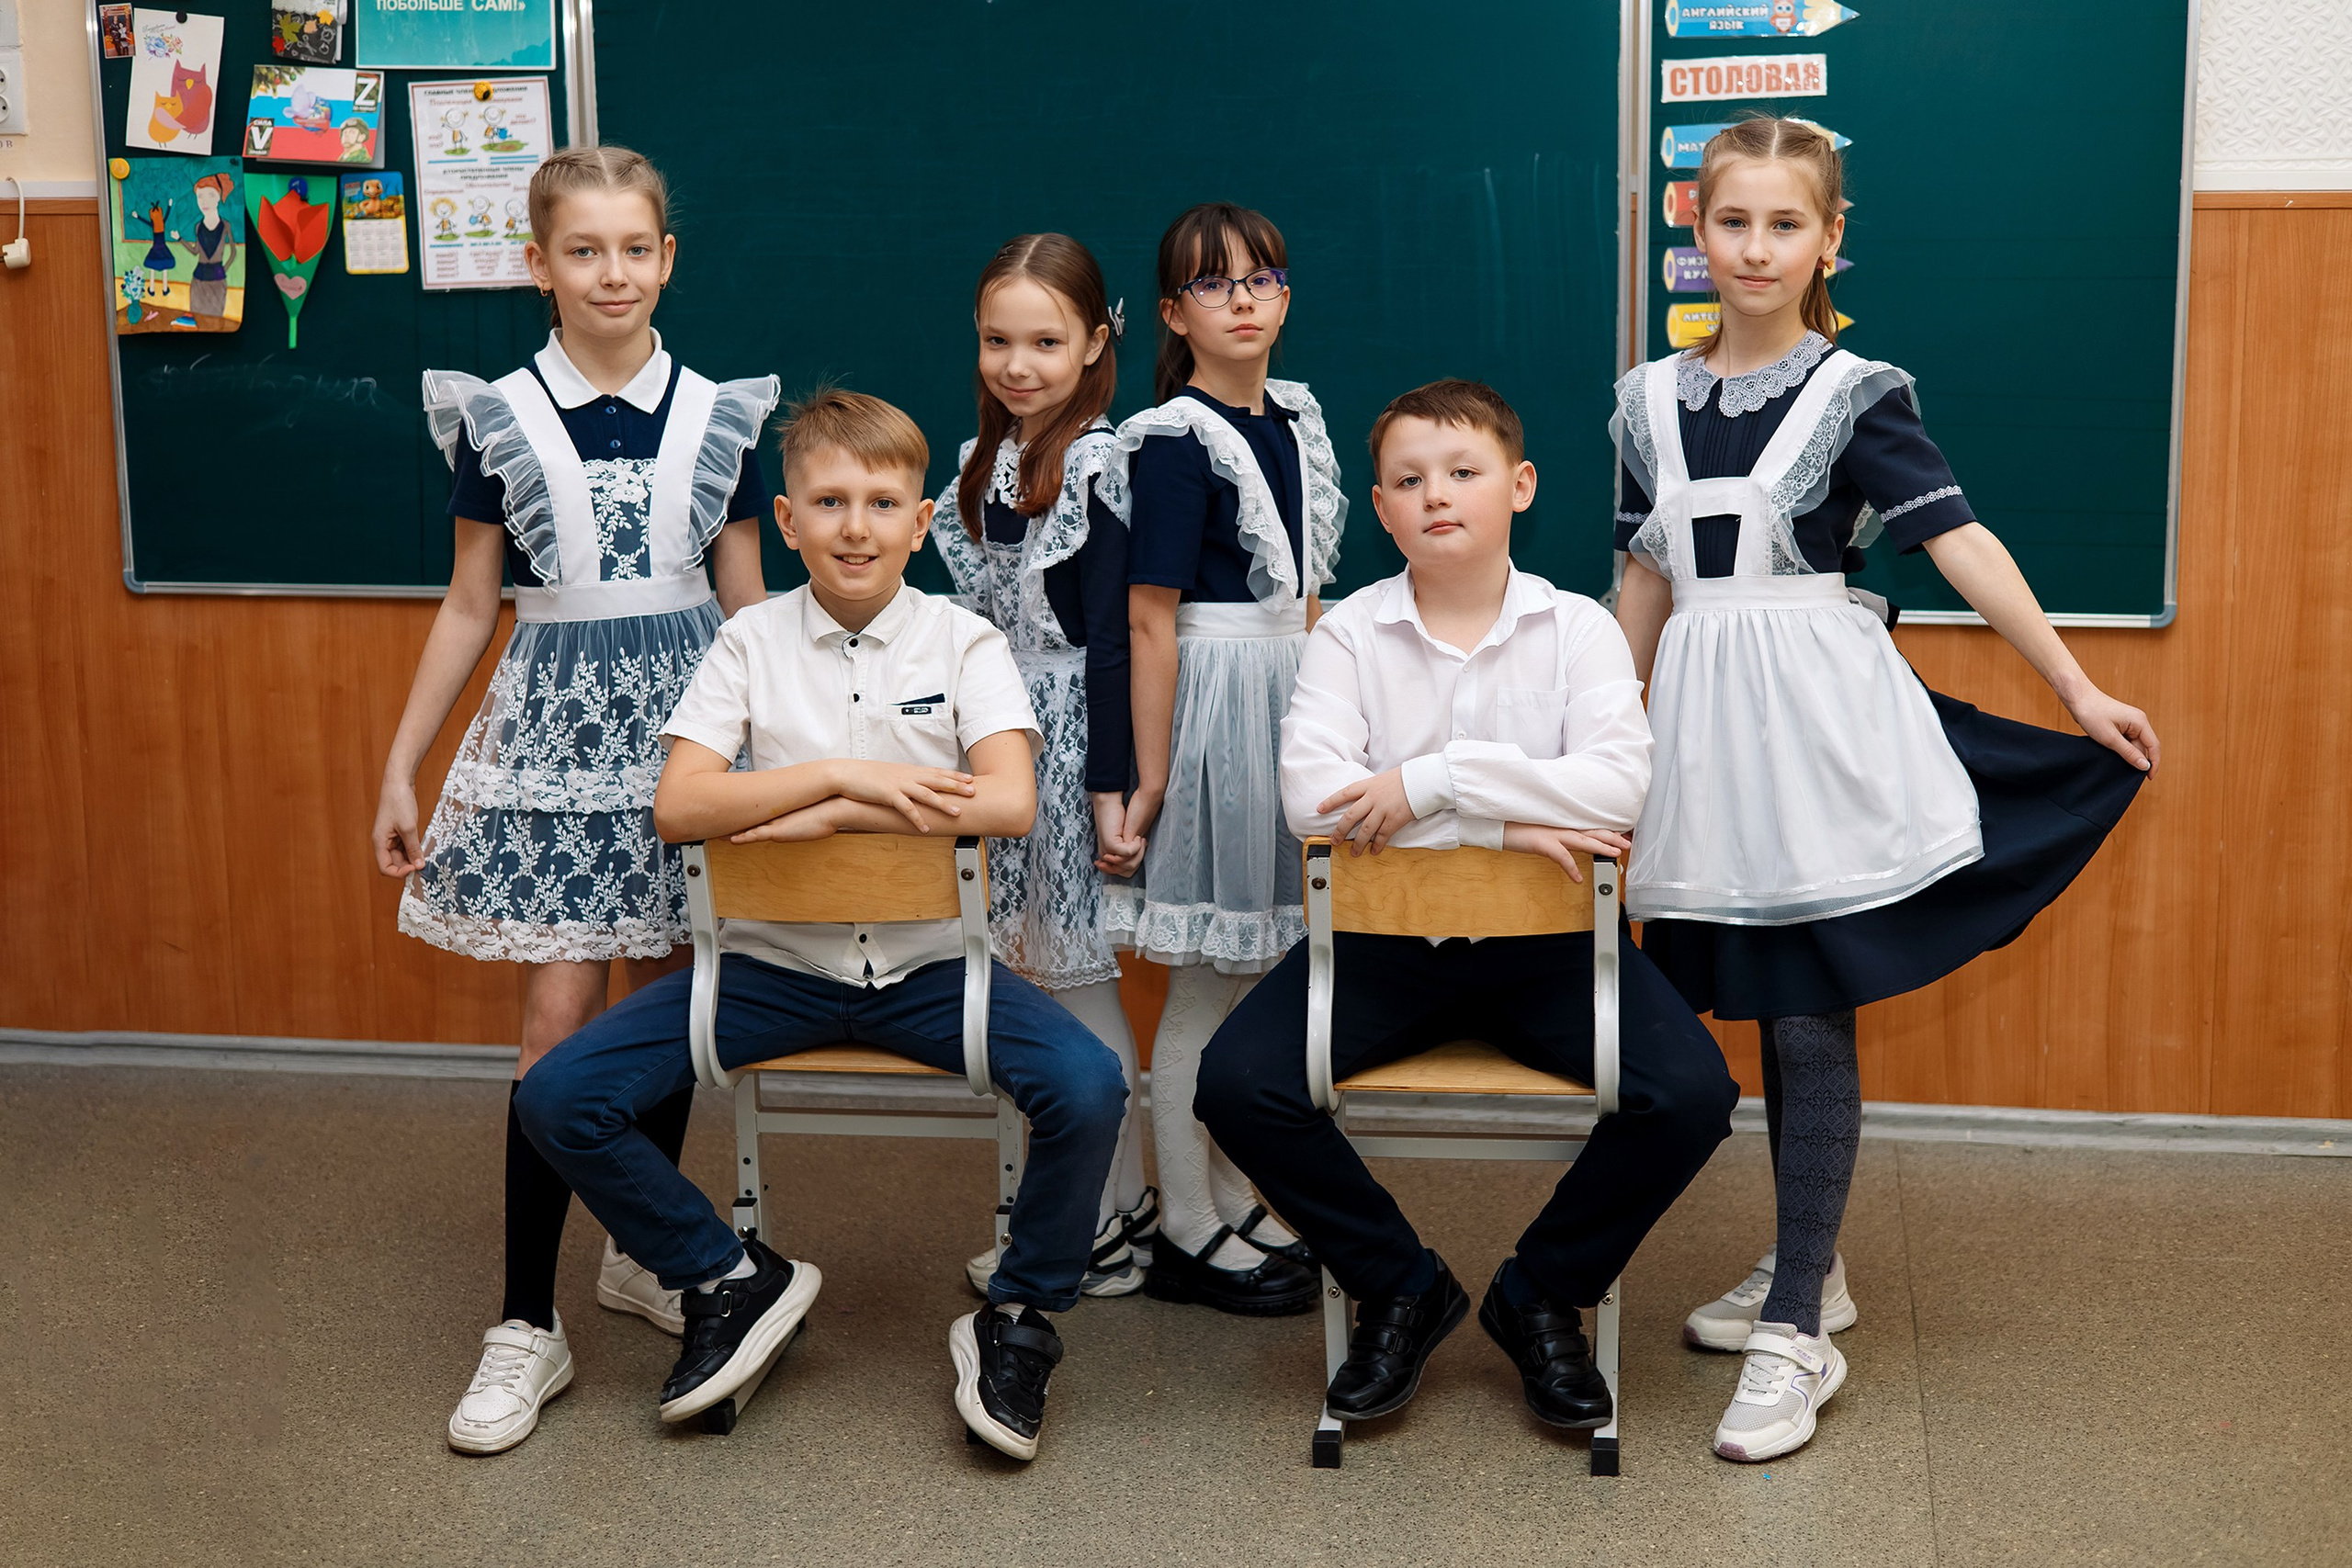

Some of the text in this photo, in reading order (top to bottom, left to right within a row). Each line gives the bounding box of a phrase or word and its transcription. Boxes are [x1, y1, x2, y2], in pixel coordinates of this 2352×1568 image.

[377, 0, 464, 11] ПОБОЛЬШЕ
[1681, 5, 1769, 18] АНГЛИЙСКИЙ
[1709, 19, 1744, 30] ЯЗЫК
[1669, 62, 1820, 96] СТОЛОВАЯ
[354, 76, 378, 107] Z
[251, 126, 274, 150] V
[1677, 141, 1706, 153] МАТ
[1676, 256, 1709, 267] ФИЗ
[1683, 269, 1711, 280] КУЛ
[1682, 312, 1721, 322] ЛИТЕР
